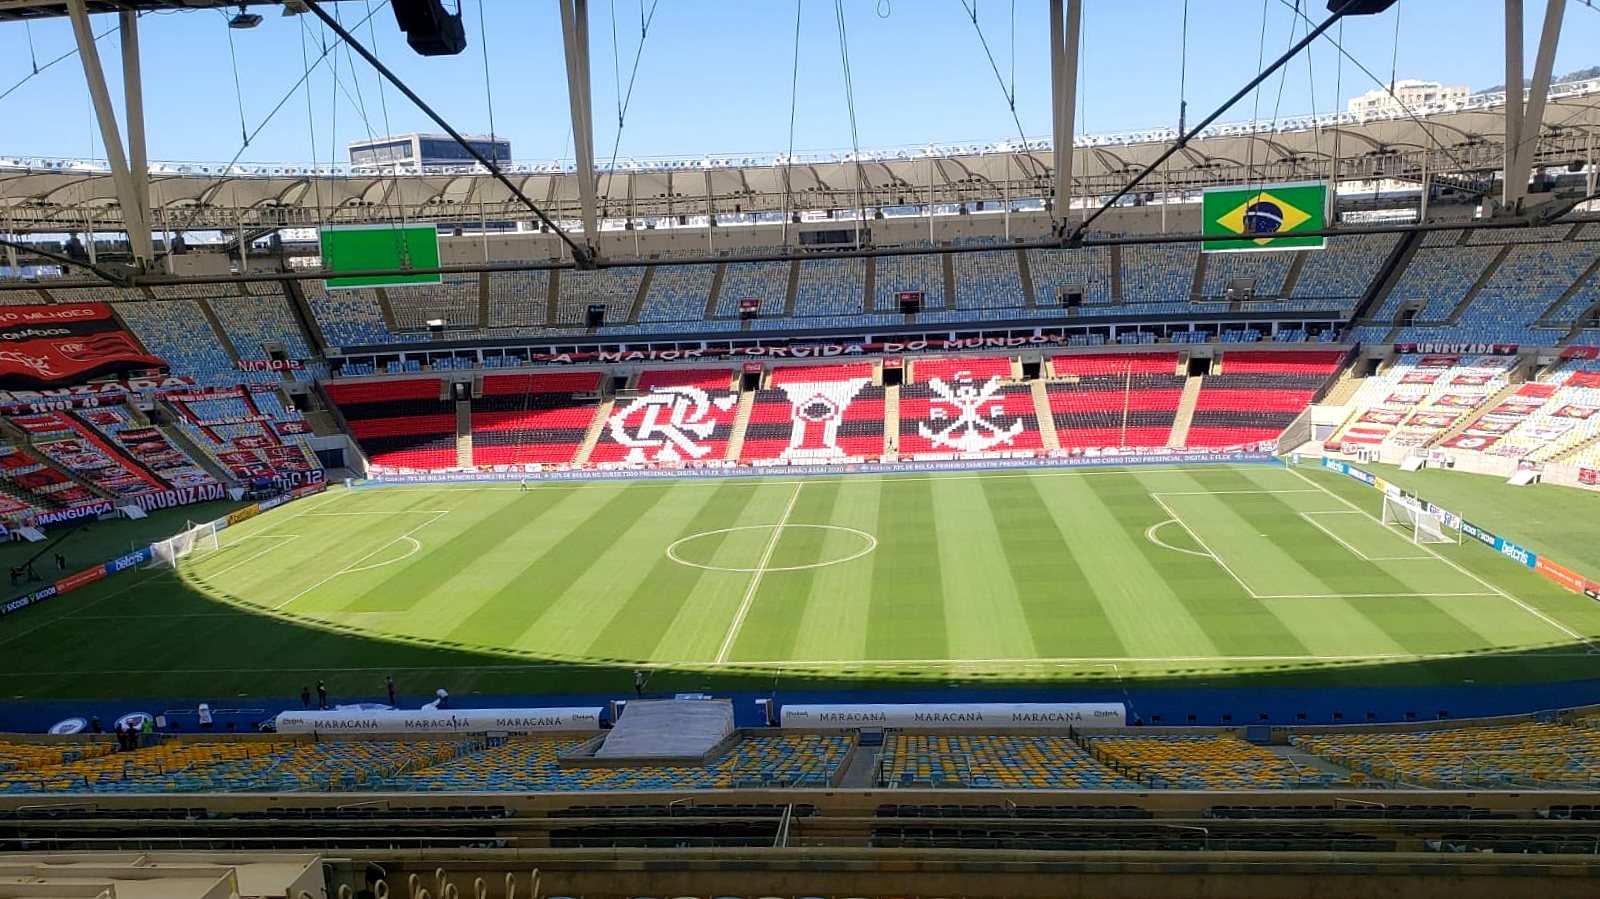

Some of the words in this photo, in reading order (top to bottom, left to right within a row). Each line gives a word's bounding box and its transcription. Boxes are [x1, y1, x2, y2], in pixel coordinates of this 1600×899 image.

[0, 328, 72, 339] ONADOS
[550, 353, 573, 363] A
[599, 349, 703, 361] MAIOR
[724, 345, 864, 357] TORCIDA
[883, 340, 928, 352] DO
[943, 336, 1048, 349] MUNDO
[1416, 343, 1494, 354] URUBUZADA
[285, 360, 301, 369] 12
[29, 400, 74, 414] SETOR
[82, 397, 100, 408] 40
[304, 470, 323, 485] 12
[136, 483, 226, 512] URUBUZADA
[37, 502, 113, 525] MANGUAÇA
